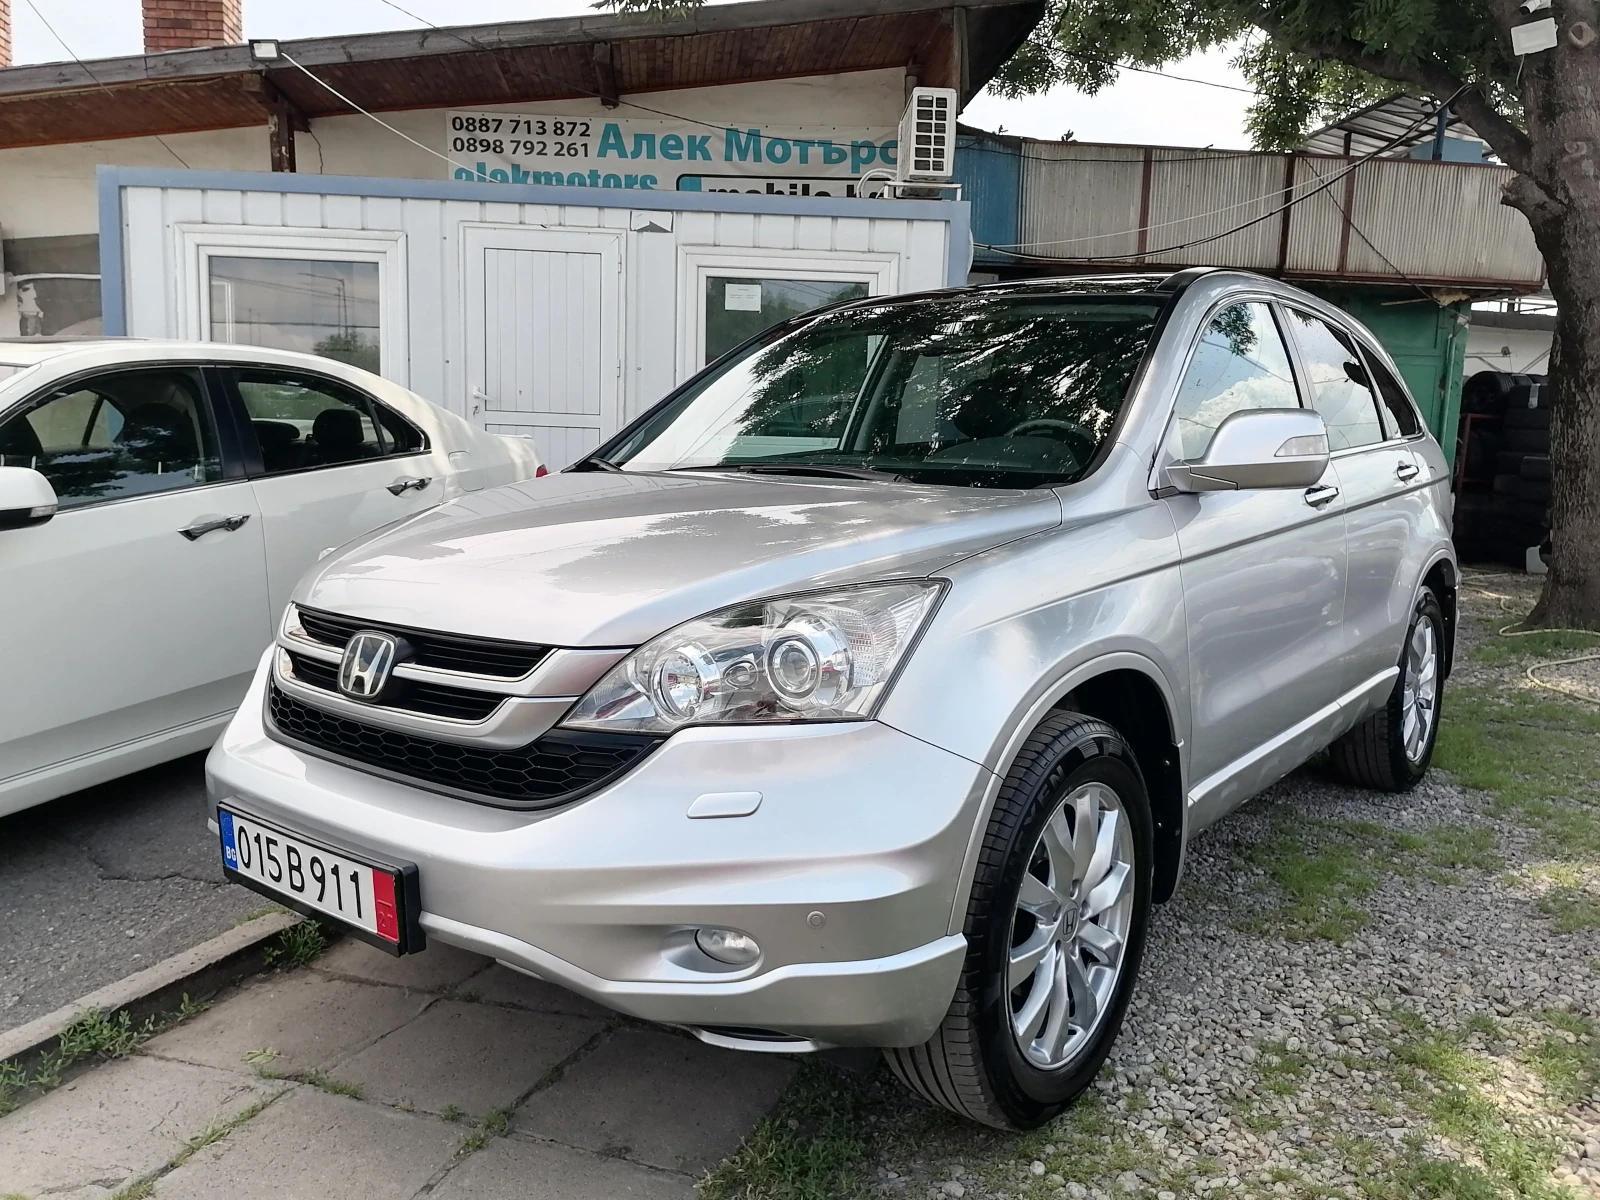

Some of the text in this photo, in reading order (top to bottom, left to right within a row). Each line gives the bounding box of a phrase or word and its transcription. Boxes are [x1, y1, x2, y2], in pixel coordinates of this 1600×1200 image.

[451, 116, 591, 137] 0887 713 872
[452, 137, 589, 158] 0898 792 261
[597, 123, 898, 174] Алек Мотърс
[225, 845, 237, 862] BG
[237, 825, 362, 919] 015B911
